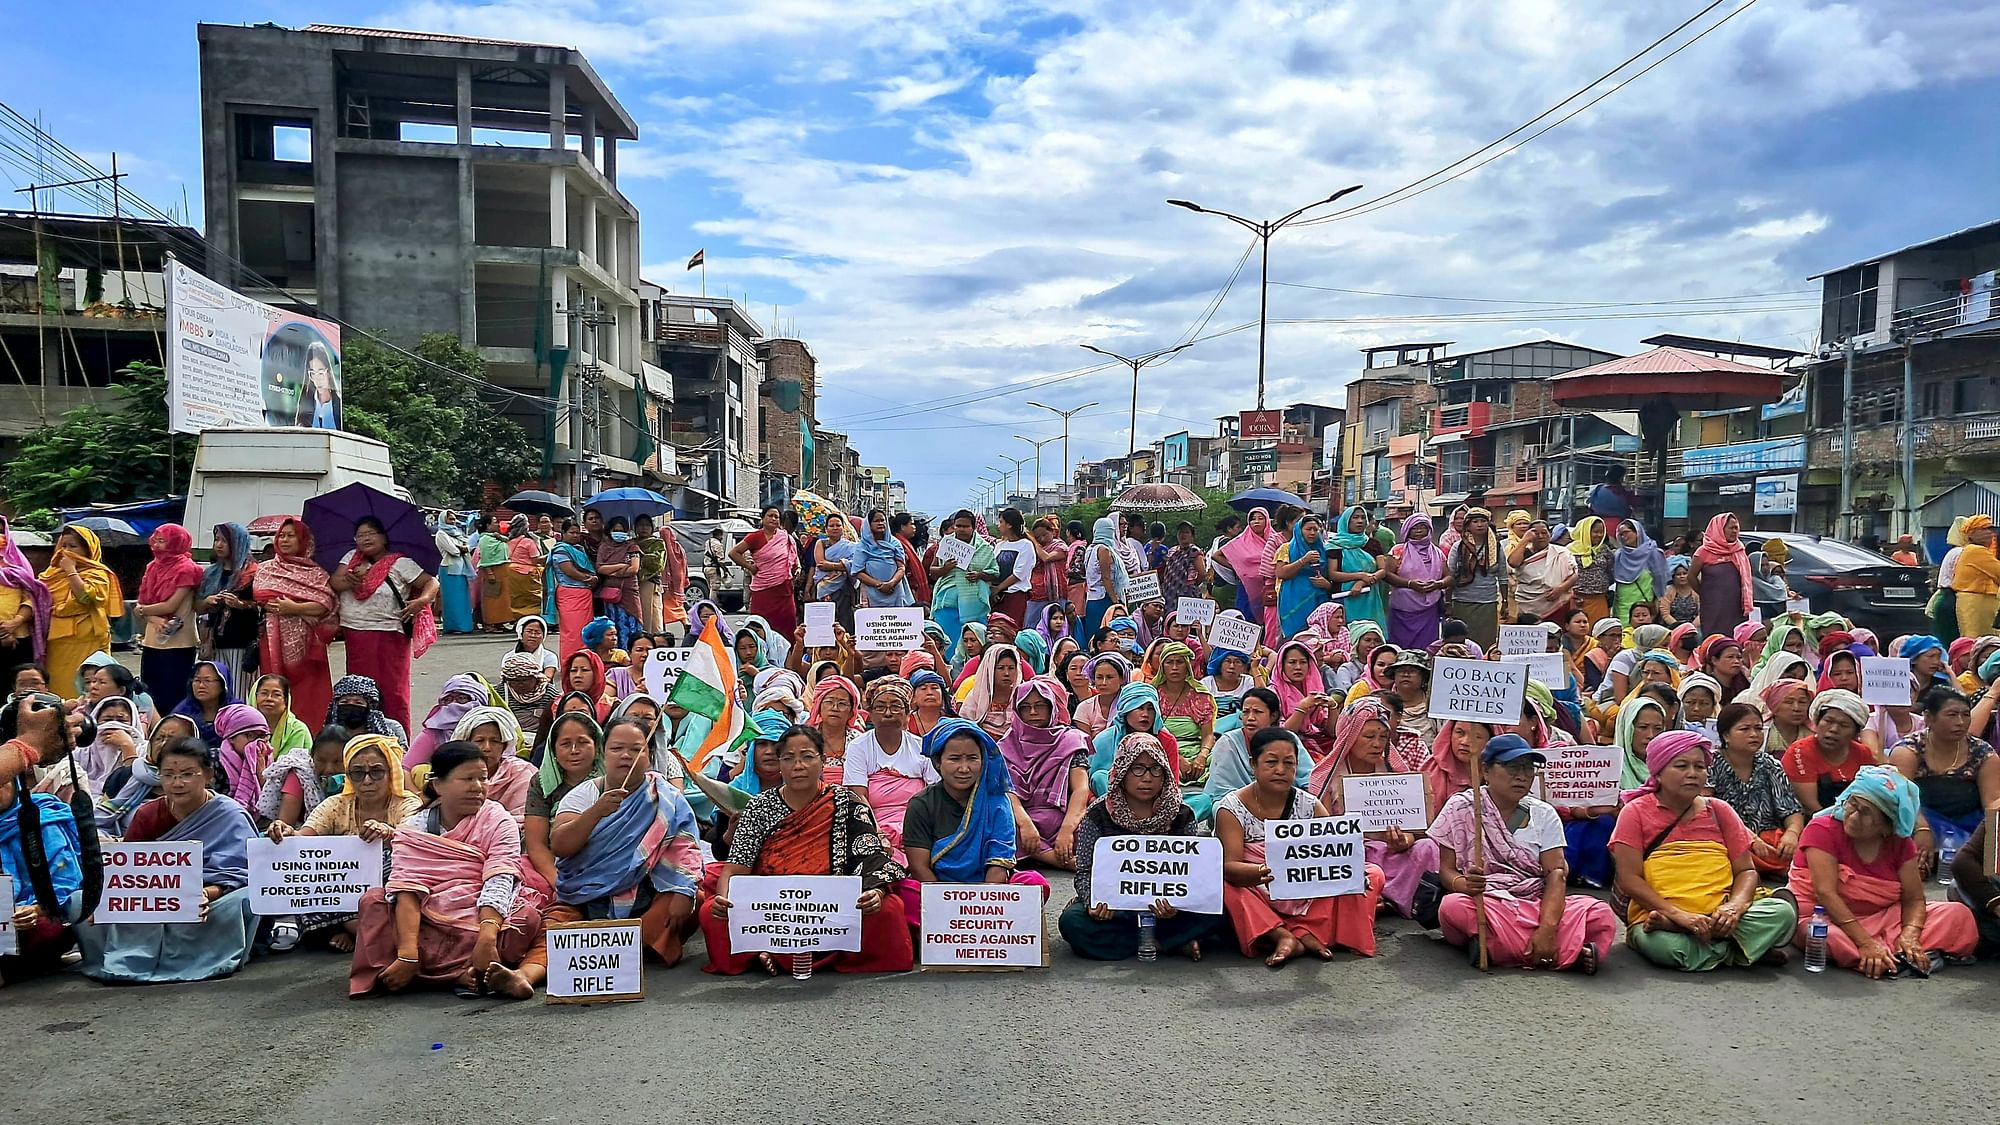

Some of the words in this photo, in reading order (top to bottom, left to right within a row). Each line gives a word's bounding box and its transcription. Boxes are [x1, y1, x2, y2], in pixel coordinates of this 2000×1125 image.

[182, 307, 196, 319] YOUR
[182, 319, 205, 338] MBBS
[1218, 619, 1231, 627] GO
[1232, 621, 1256, 635] BACK
[1220, 628, 1250, 641] ASSAM
[1519, 630, 1543, 638] BACK
[1218, 635, 1247, 649] RIFLES
[1509, 639, 1538, 647] ASSAM
[656, 651, 677, 662] GO
[1507, 647, 1537, 655] RIFLES
[1443, 667, 1467, 680] GO
[1471, 669, 1516, 684] BACK
[1449, 683, 1507, 699] ASSAM
[1449, 698, 1504, 714] RIFLES
[1561, 750, 1589, 758] STOP
[1574, 760, 1611, 768] INDIAN
[1548, 770, 1600, 779] SECURITY
[1545, 781, 1570, 789] RCES
[1572, 780, 1619, 789] AGAINST
[1369, 789, 1399, 797] INDIAN
[1552, 790, 1594, 799] MEITEIS
[1364, 798, 1405, 807] SECURITY
[1361, 809, 1383, 817] RCES
[1384, 807, 1421, 816] AGAINST
[1369, 818, 1403, 826] MEITEIS
[1274, 823, 1305, 839] GO
[1309, 818, 1362, 837] BACK
[1111, 839, 1140, 852] GO
[1145, 840, 1200, 855] BACK
[1284, 842, 1353, 860] ASSAM
[101, 851, 128, 867] GO
[133, 851, 192, 867] BACK
[299, 849, 332, 859] STOP
[271, 861, 312, 871] USING
[315, 861, 359, 870] INDIAN
[1119, 859, 1189, 876] ASSAM
[283, 872, 348, 884] SECURITY
[1286, 864, 1353, 883] RIFLES
[107, 874, 181, 889] ASSAM
[260, 886, 311, 896] FORCES
[314, 884, 371, 894] AGAINST
[779, 889, 812, 900] STOP
[1120, 880, 1188, 897] RIFLES
[290, 896, 341, 908] MEITEIS
[943, 890, 977, 901] STOP
[980, 891, 1020, 902] USING
[108, 897, 181, 912] RIFLES
[751, 902, 792, 911] USING
[795, 902, 839, 913] INDIAN
[959, 905, 1004, 916] INDIAN
[764, 912, 826, 925] SECURITY
[949, 919, 1014, 930] SECURITY
[741, 925, 791, 935] FORCES
[793, 926, 850, 936] AGAINST
[553, 931, 634, 950] WITHDRAW
[770, 937, 820, 948] MEITEIS
[926, 933, 977, 944] FORCES
[979, 934, 1037, 945] AGAINST
[955, 948, 1008, 959] MEITEIS
[568, 953, 620, 971] ASSAM
[573, 976, 614, 993] RIFLE
